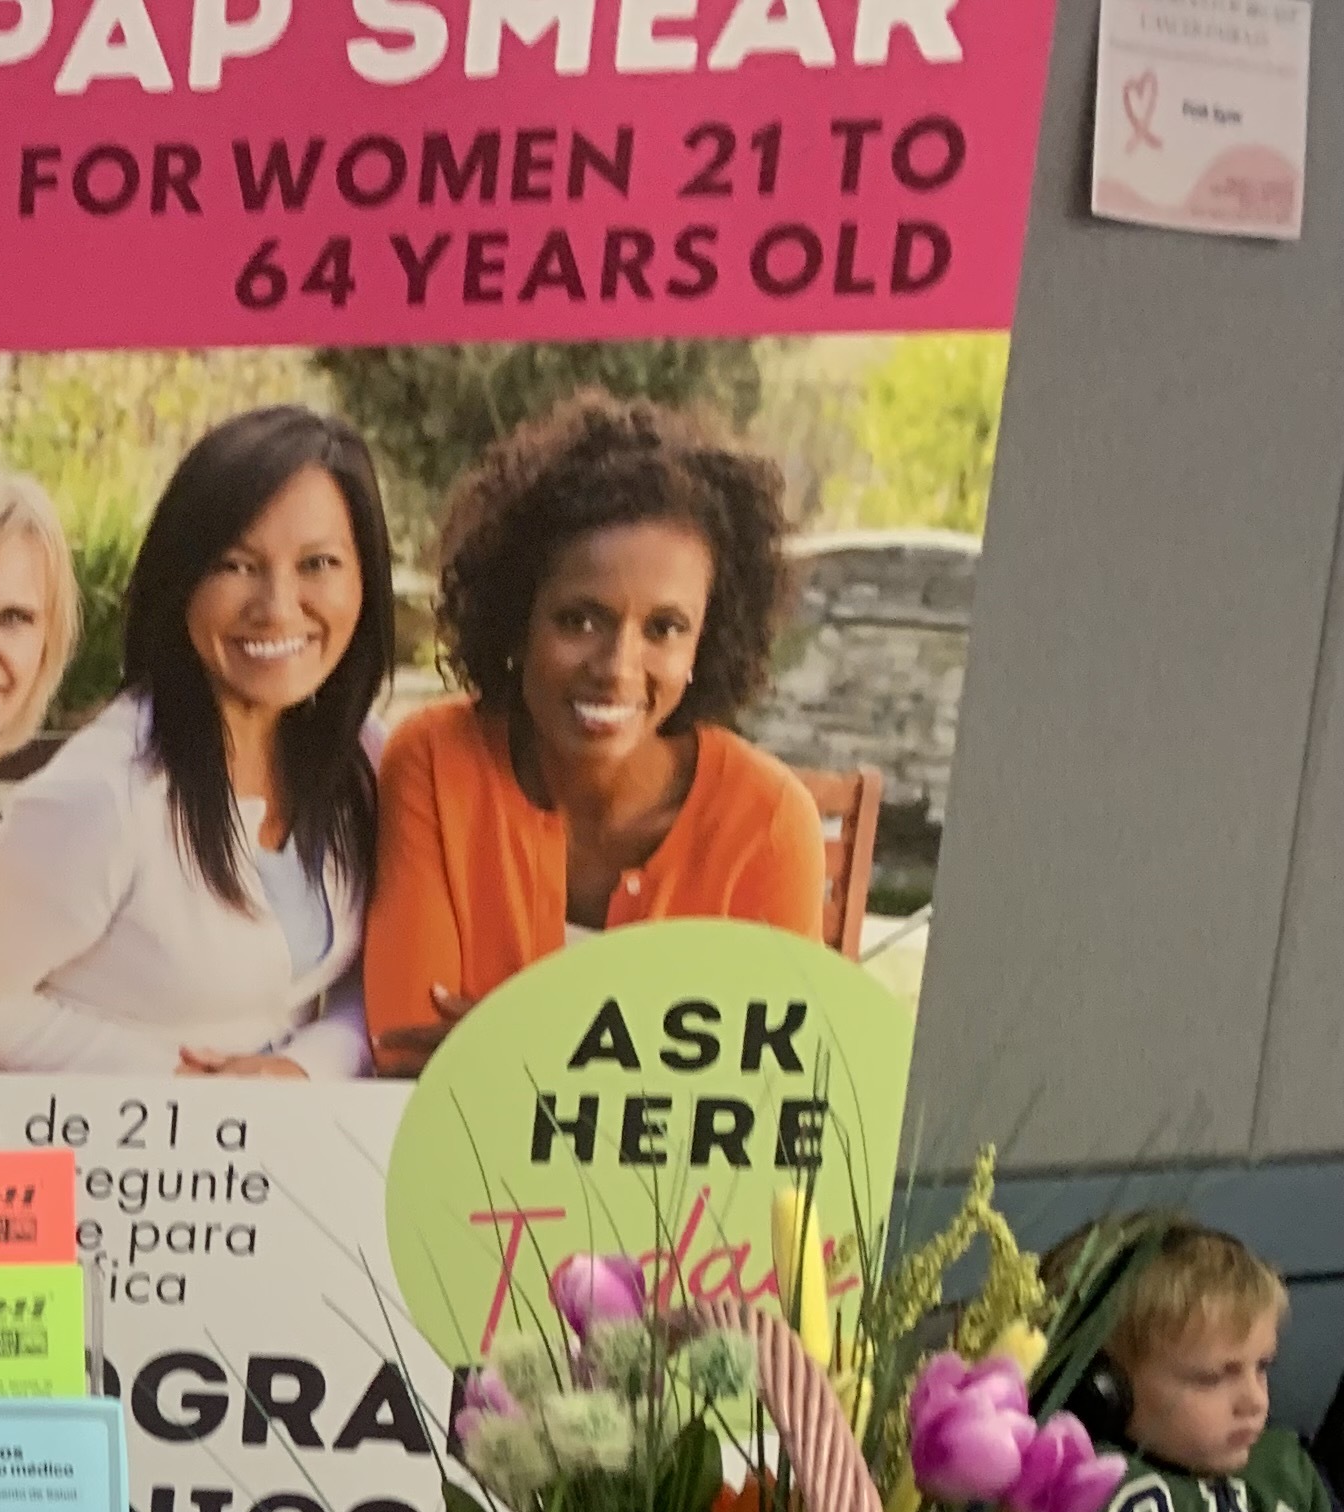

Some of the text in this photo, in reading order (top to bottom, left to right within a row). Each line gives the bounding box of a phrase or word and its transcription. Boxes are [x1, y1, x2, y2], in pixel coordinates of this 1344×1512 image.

[346, 0, 964, 87] SMEAR
[18, 115, 966, 221] FOR WOMEN 21 TO
[235, 219, 952, 312] 64 YEARS OLD
[567, 996, 808, 1074] ASK
[25, 1095, 91, 1147] de
[116, 1099, 182, 1150] 21
[216, 1116, 248, 1151] a
[529, 1091, 830, 1169] HERE
[75, 1163, 271, 1214] egunte
[128, 1220, 258, 1267] para
[10, 1461, 74, 1478] médico
